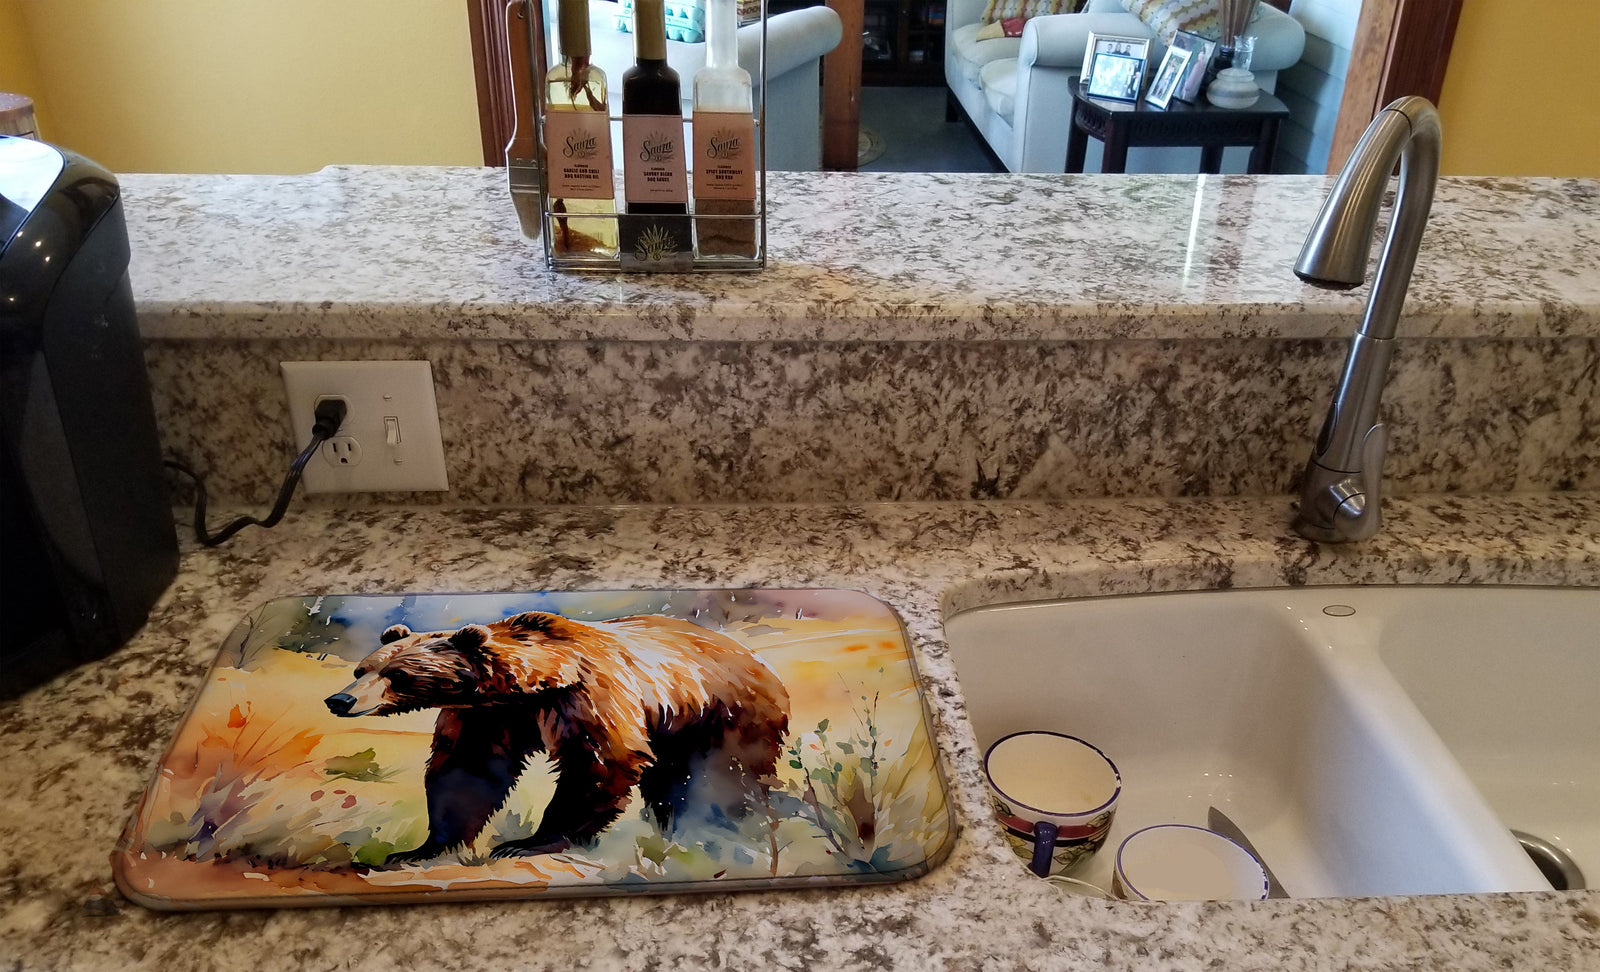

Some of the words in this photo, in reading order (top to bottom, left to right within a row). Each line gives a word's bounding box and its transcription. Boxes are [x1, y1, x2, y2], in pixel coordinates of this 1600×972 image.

[563, 136, 598, 158] Sauza
[640, 140, 674, 162] Sauza
[706, 137, 741, 159] Sauza
